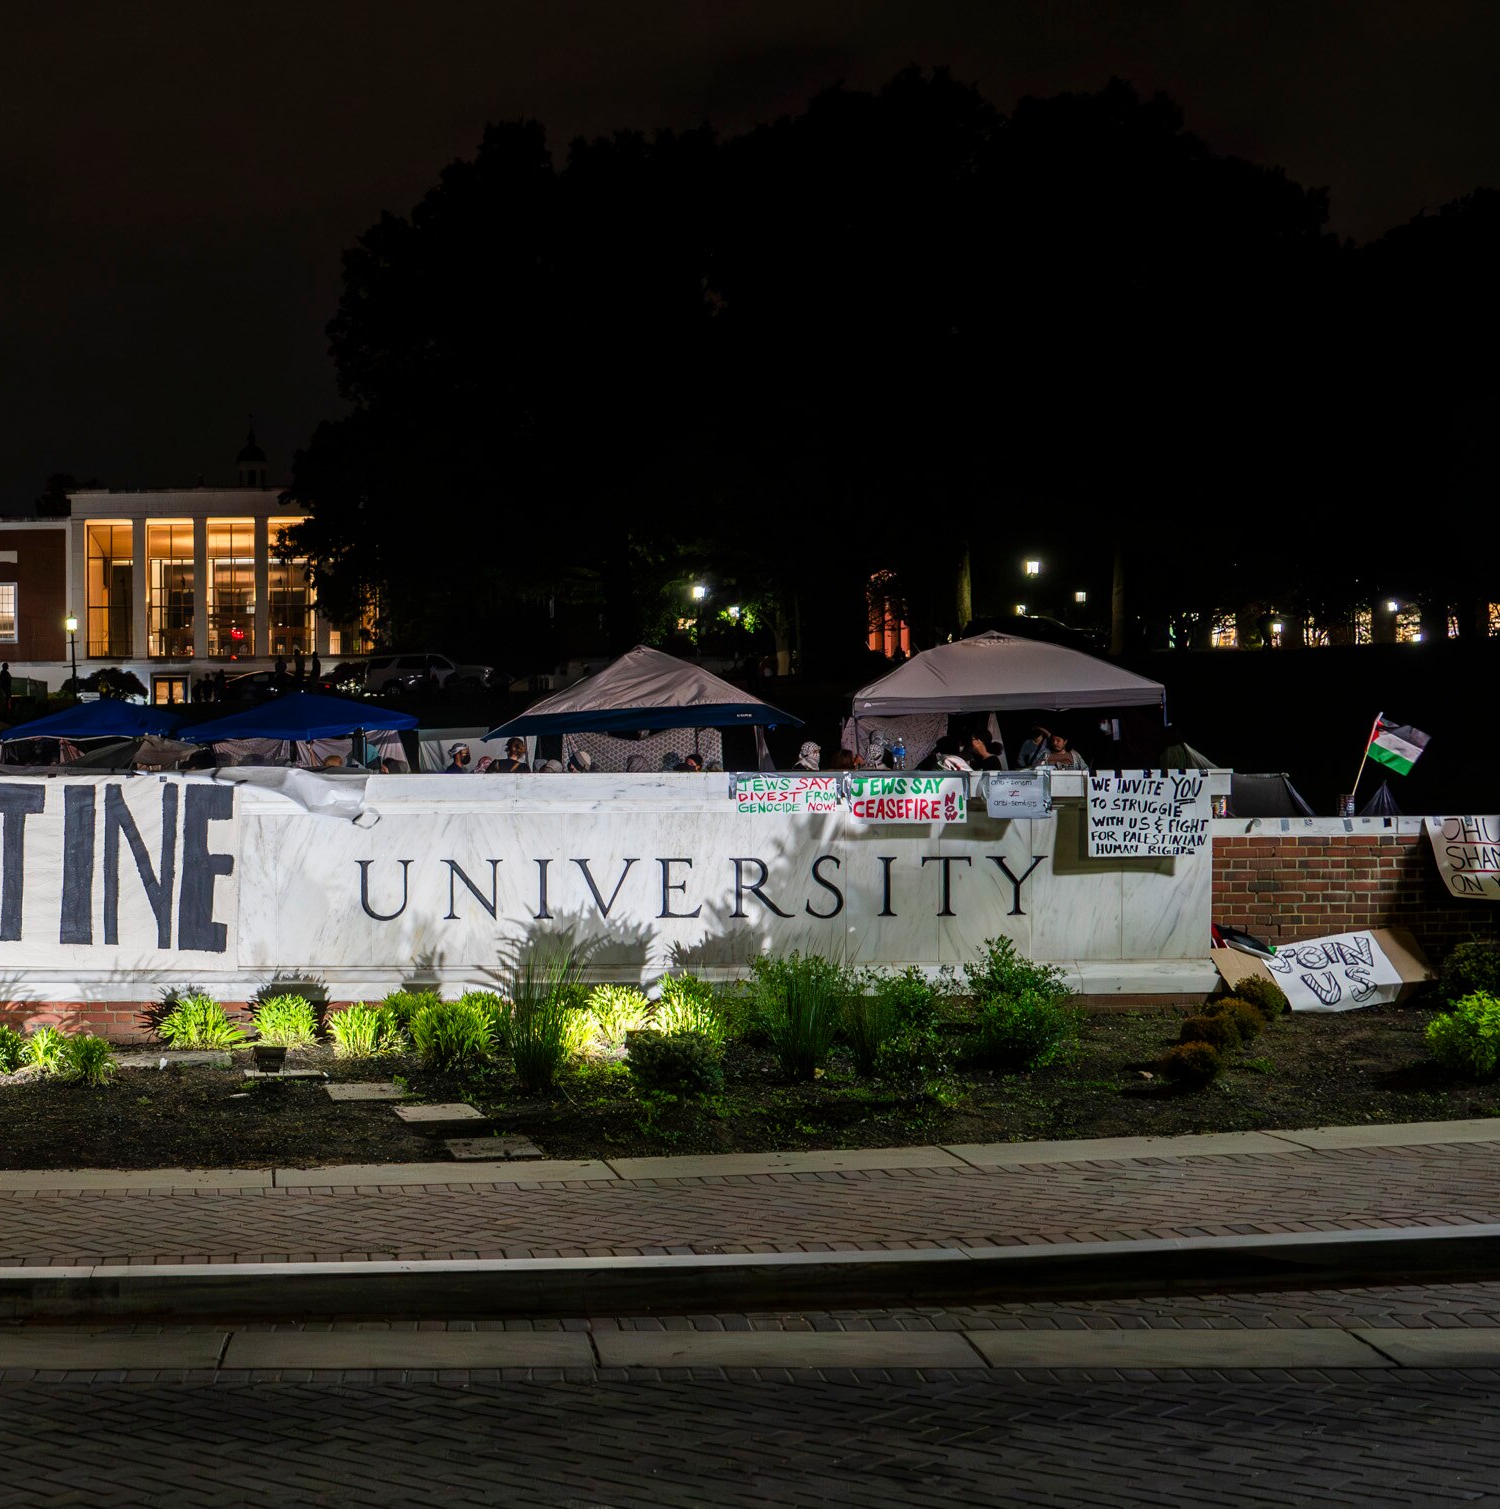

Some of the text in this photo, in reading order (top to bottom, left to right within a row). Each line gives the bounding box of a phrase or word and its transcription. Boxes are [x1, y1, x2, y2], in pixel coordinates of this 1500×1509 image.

[736, 778, 791, 792] JEWS
[851, 777, 945, 797] JEWS SAY
[1091, 775, 1203, 799] WE INVITE YOU
[738, 790, 837, 804] DIVEST FROM
[1090, 797, 1107, 810] TO
[738, 801, 836, 814] GENOCIDE NOW!
[853, 798, 942, 821] CEASEFIRE
[1091, 815, 1209, 834] WITH US & FIGHT
[1091, 830, 1208, 847] FOR PALESTINIAN
[1095, 842, 1196, 856] HUMAN RIGHTS
[354, 854, 1049, 921] UNIVERSITY
[1451, 874, 1485, 893] ON
[1268, 936, 1375, 974] JOIN
[1299, 966, 1379, 1007] US
